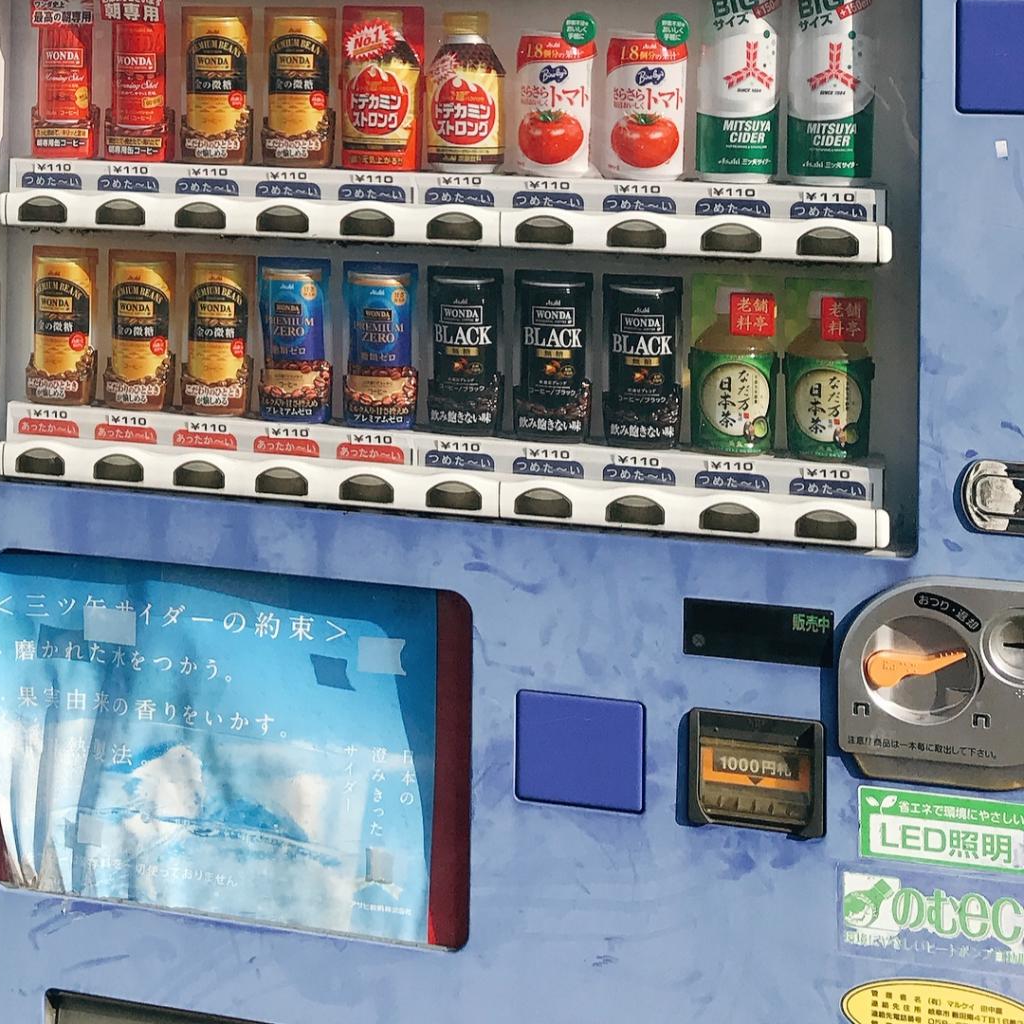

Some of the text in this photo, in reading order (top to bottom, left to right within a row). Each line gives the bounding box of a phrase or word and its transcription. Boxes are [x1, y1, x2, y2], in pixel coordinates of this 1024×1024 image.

[713, 14, 750, 30] サイズ
[799, 14, 833, 32] サイズ
[46, 50, 80, 62] WONDA
[118, 55, 152, 66] WONDA
[197, 56, 229, 66] WONDA
[279, 56, 310, 65] WONDA
[351, 93, 401, 111] ドデカミン
[550, 85, 589, 109] トマト
[646, 87, 683, 111] トマト
[435, 104, 491, 120] ドデカミン
[353, 112, 398, 129] ストロング
[723, 120, 771, 131] MITSUYA
[437, 120, 489, 136] ストロング
[807, 123, 857, 134] MITSUYA
[730, 132, 765, 143] CIDER
[813, 135, 851, 146] CIDER
[37, 163, 71, 172] ¥110
[113, 166, 148, 174] ¥110
[192, 168, 228, 177] ¥110
[270, 171, 307, 180] ¥110
[355, 174, 393, 184] ¥110
[442, 177, 481, 186] ¥110
[529, 180, 570, 190] ¥110
[619, 184, 660, 194] ¥110
[713, 188, 756, 197] ¥110
[806, 191, 854, 202] ¥110
[41, 298, 70, 307] WONDA
[120, 303, 150, 312] WONDA
[200, 304, 231, 313] WONDA
[444, 308, 479, 319] WONDA
[537, 309, 571, 320] WONDA
[625, 317, 660, 327] WONDA
[737, 316, 769, 332] 料亭
[273, 326, 305, 337] ZERO
[828, 321, 862, 337] 料亭
[362, 332, 395, 343] ZERO
[435, 325, 492, 345] BLACK
[525, 327, 582, 348] BLACK
[613, 334, 672, 355] BLACK
[737, 370, 750, 411] なだ万
[828, 376, 840, 417] なだ万
[718, 377, 736, 429] 日本茶
[808, 382, 826, 434] 日本茶
[33, 409, 68, 419] ¥110
[111, 415, 146, 425] ¥110
[191, 422, 227, 432] ¥110
[272, 428, 309, 437] ¥110
[353, 434, 392, 444] ¥110
[440, 441, 480, 451] ¥110
[530, 448, 570, 459] ¥110
[618, 456, 659, 467] ¥110
[711, 461, 753, 471] ¥110
[807, 469, 850, 479] ¥110
[918, 593, 979, 630] おつり・返却
[792, 613, 830, 634] 販売中
[881, 822, 1013, 864] LED照明
